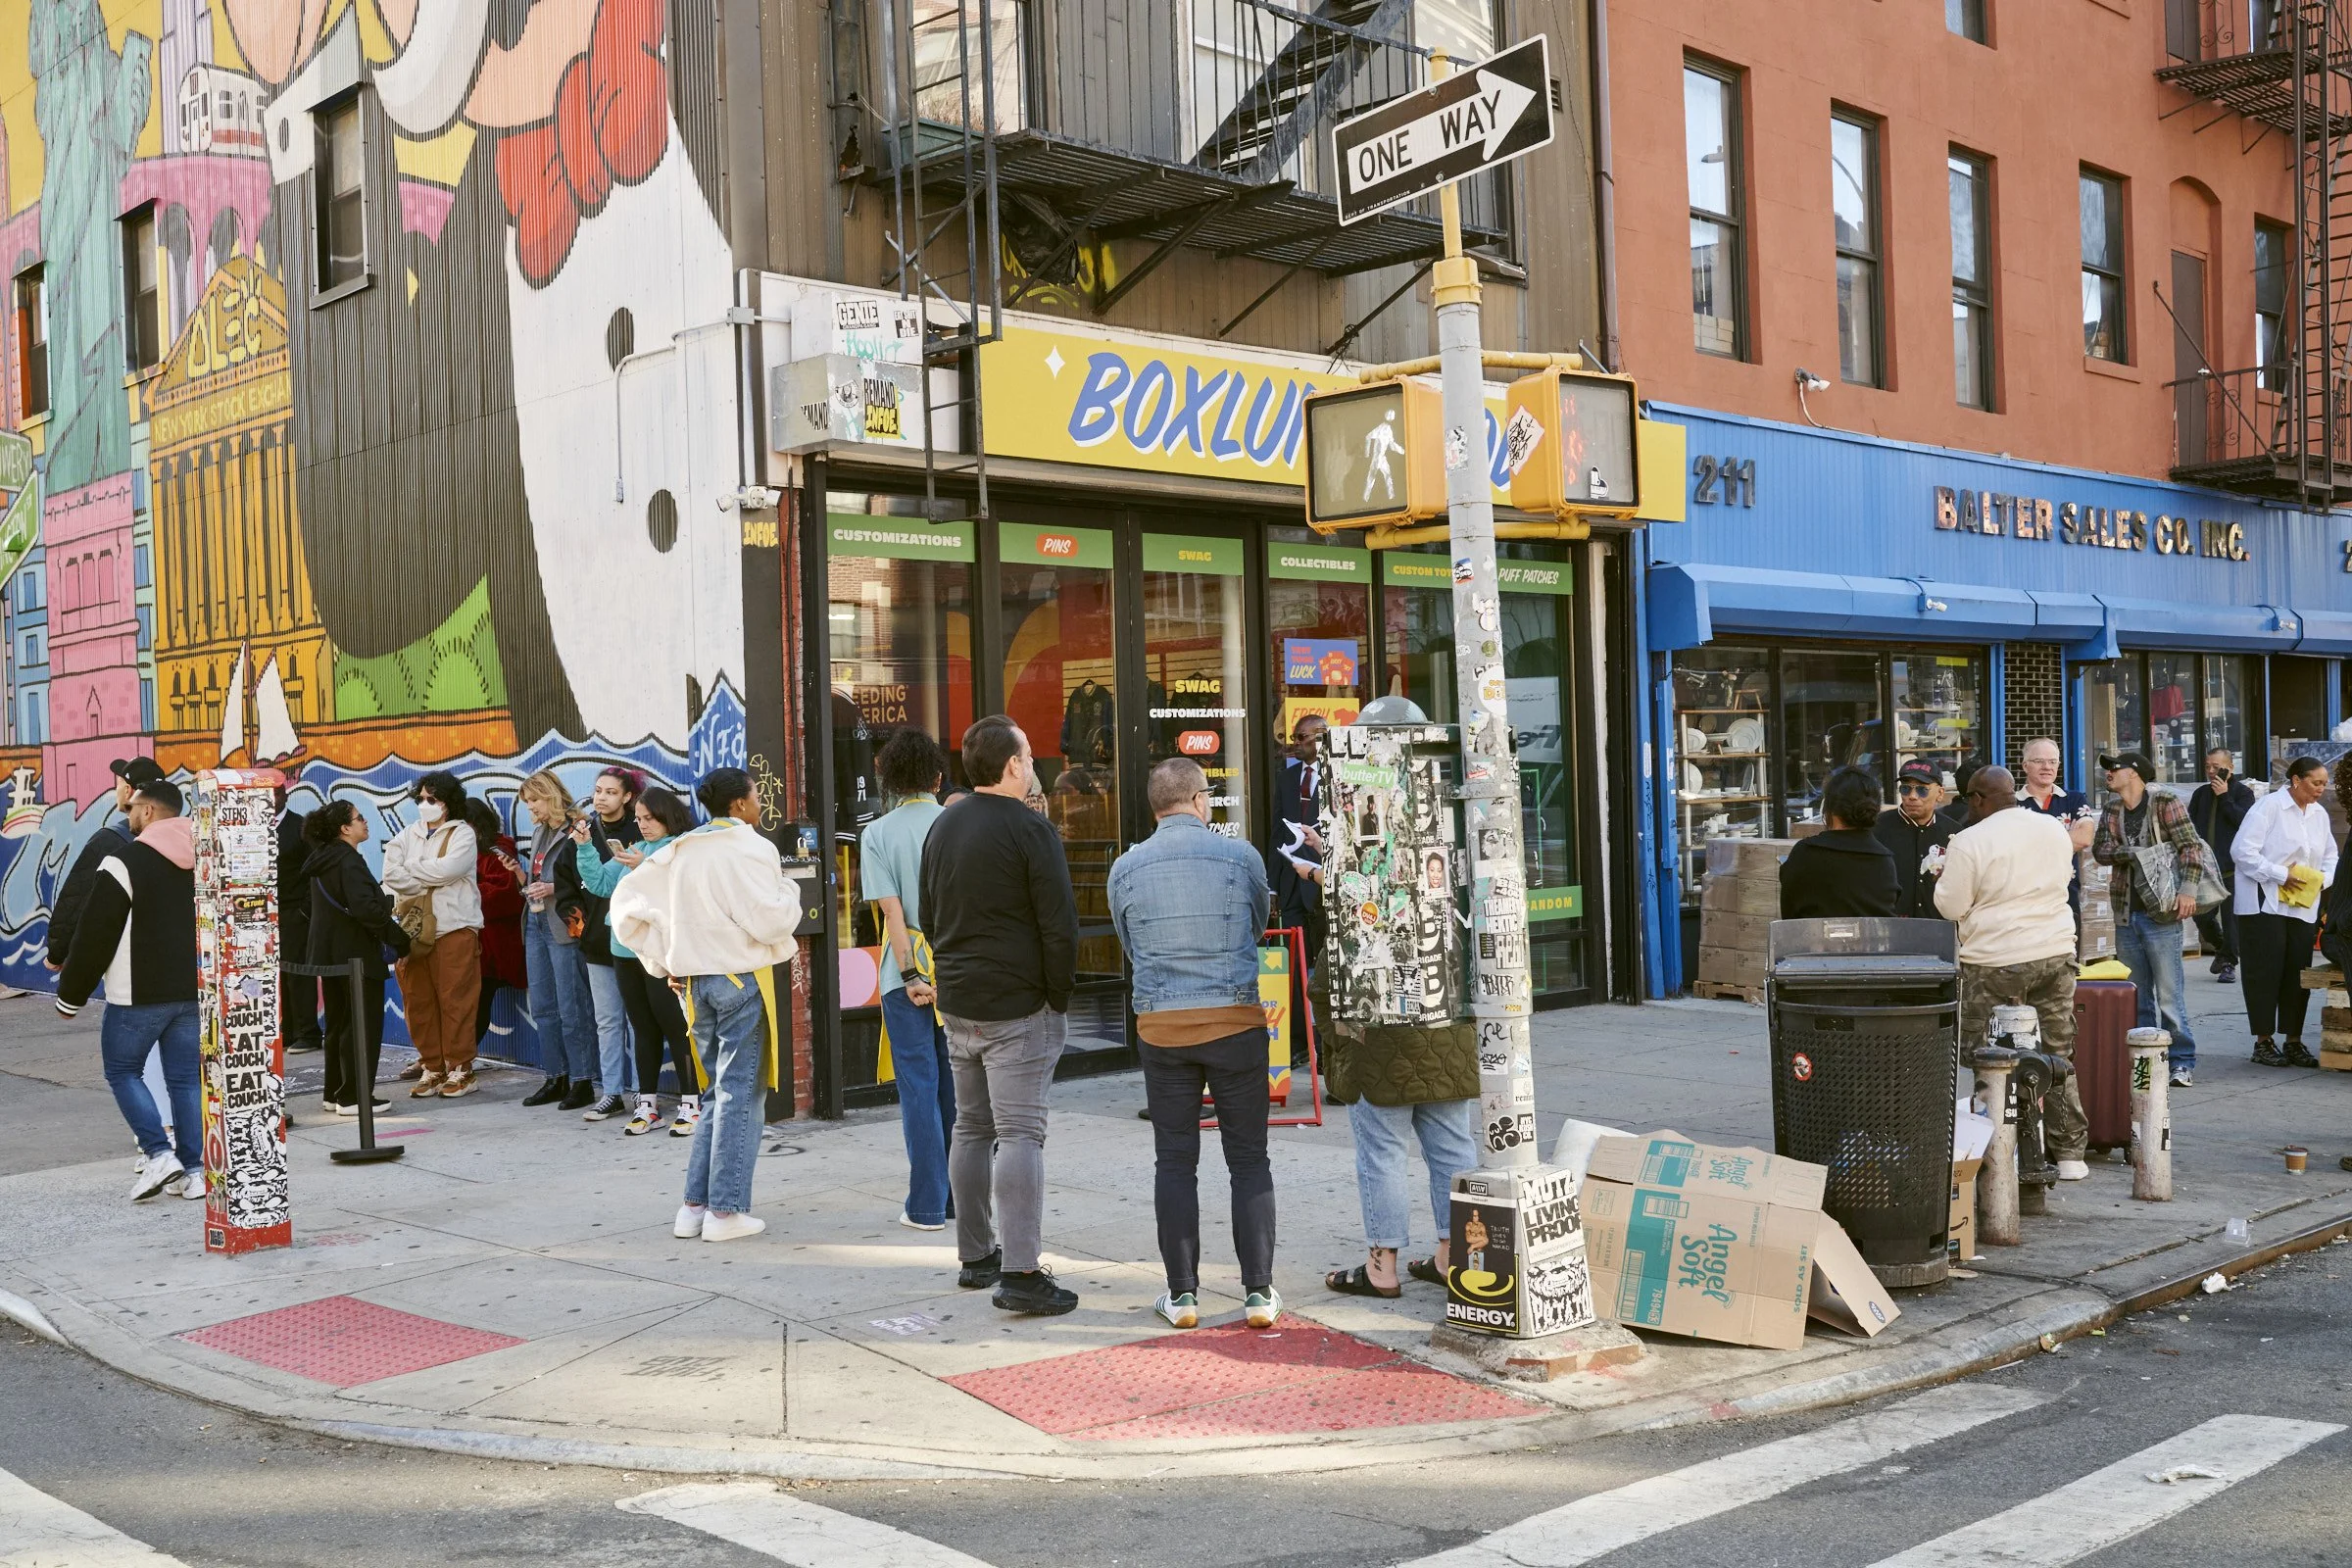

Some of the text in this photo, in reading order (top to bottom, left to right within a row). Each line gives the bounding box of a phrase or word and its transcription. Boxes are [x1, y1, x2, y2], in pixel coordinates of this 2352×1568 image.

[1358, 89, 1501, 182] ONE WAY
[1367, 189, 1411, 211] TRANSPORTATION
[837, 301, 879, 325] GENIE
[863, 378, 896, 409] REMAND
[154, 418, 178, 442] NEW
[179, 406, 209, 435] YORK
[210, 392, 245, 427] STOCK
[1693, 455, 1756, 509] 211
[1934, 485, 2251, 562] BALTER SALES CO. INC.
[743, 522, 778, 547] INFOE
[833, 529, 961, 548] CUSTOMIZATIONS
[1043, 538, 1071, 554] PINS
[1179, 550, 1211, 562] SWAG
[1280, 557, 1356, 570] COLLECTIBLES
[1393, 564, 1433, 576] CUSTOM
[1498, 567, 1559, 584] PUFF PATCHES
[1290, 664, 1316, 679] LUCK
[853, 684, 906, 705] EEDING
[1175, 679, 1221, 694] SWAG
[862, 705, 907, 724] ERICA
[1149, 708, 1247, 718] CUSTOMIZATIONS
[1186, 735, 1214, 751] PINS
[1341, 767, 1395, 785] butterTV
[1209, 796, 1240, 808] ERCH
[222, 807, 248, 820] STEN3
[1528, 896, 1573, 911] ANDOM
[224, 1010, 264, 1029] COUCH
[225, 1051, 266, 1069] COUCH
[226, 1071, 267, 1093] EAT
[228, 1090, 268, 1108] COUCH
[1709, 1159, 1728, 1180] Soft
[1728, 1154, 1753, 1191] Angel
[1523, 1195, 1579, 1229] LIVING
[1679, 1235, 1709, 1288] Soft
[1702, 1223, 1738, 1304] Angel
[1793, 1245, 1808, 1313] SOLD AS SET
